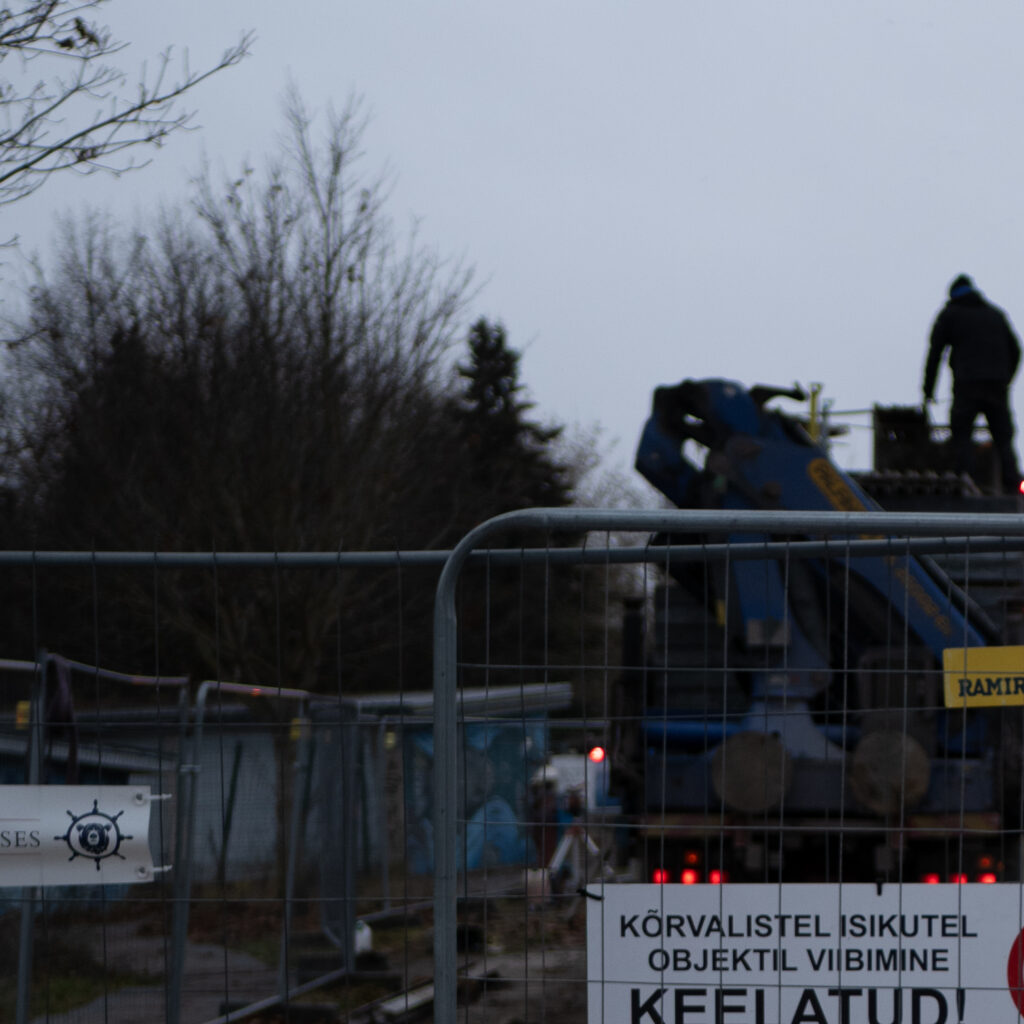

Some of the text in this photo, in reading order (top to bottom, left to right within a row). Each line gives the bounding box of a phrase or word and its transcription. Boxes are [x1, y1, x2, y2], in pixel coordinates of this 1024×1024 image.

[620, 909, 978, 938] KÕRVALISTEL ISIKUTEL
[648, 948, 949, 972] OBJEKTIL VIIBIMINE
